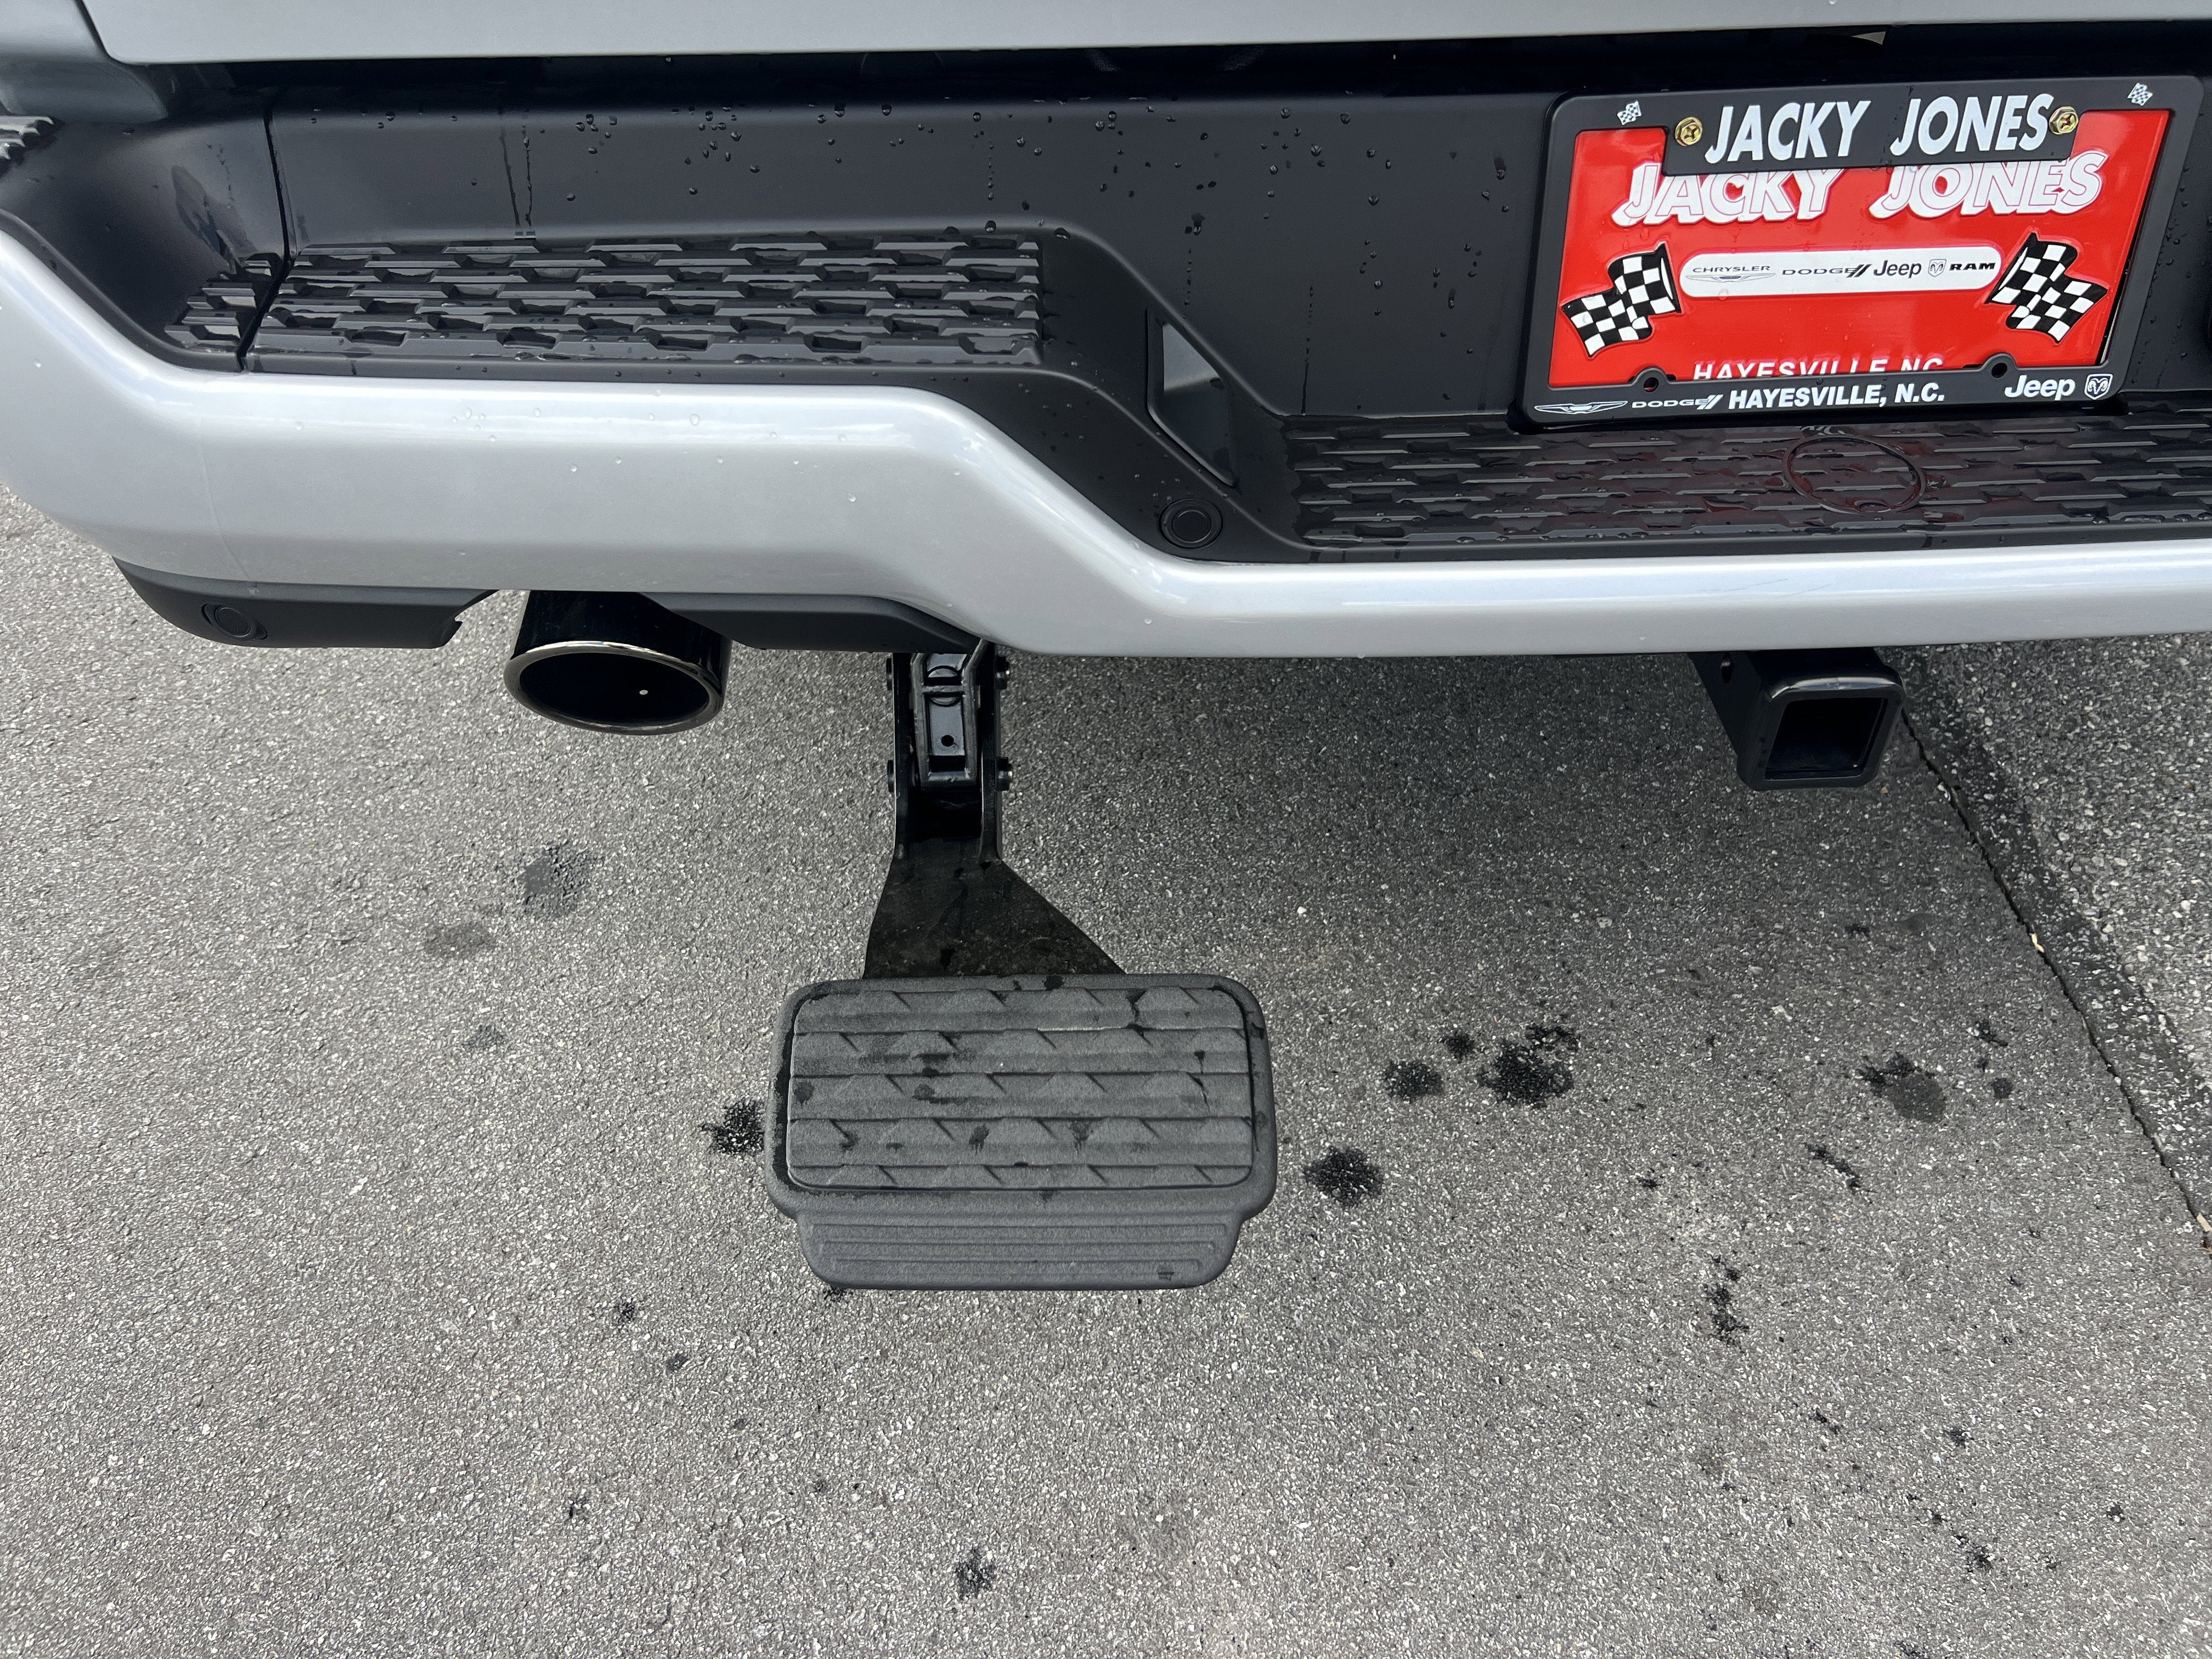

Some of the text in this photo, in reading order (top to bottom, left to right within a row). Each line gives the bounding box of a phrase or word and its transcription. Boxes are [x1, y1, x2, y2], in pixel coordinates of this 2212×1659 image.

[1705, 93, 2054, 163] JACKY JONES
[1612, 150, 2108, 227] JACKY JONES
[1873, 260, 1922, 279] Jeep
[1949, 262, 1996, 271] RAM
[1632, 382, 1945, 409] DODGE HAYESVILLE, N.C.
[2004, 375, 2076, 400] Jeep
